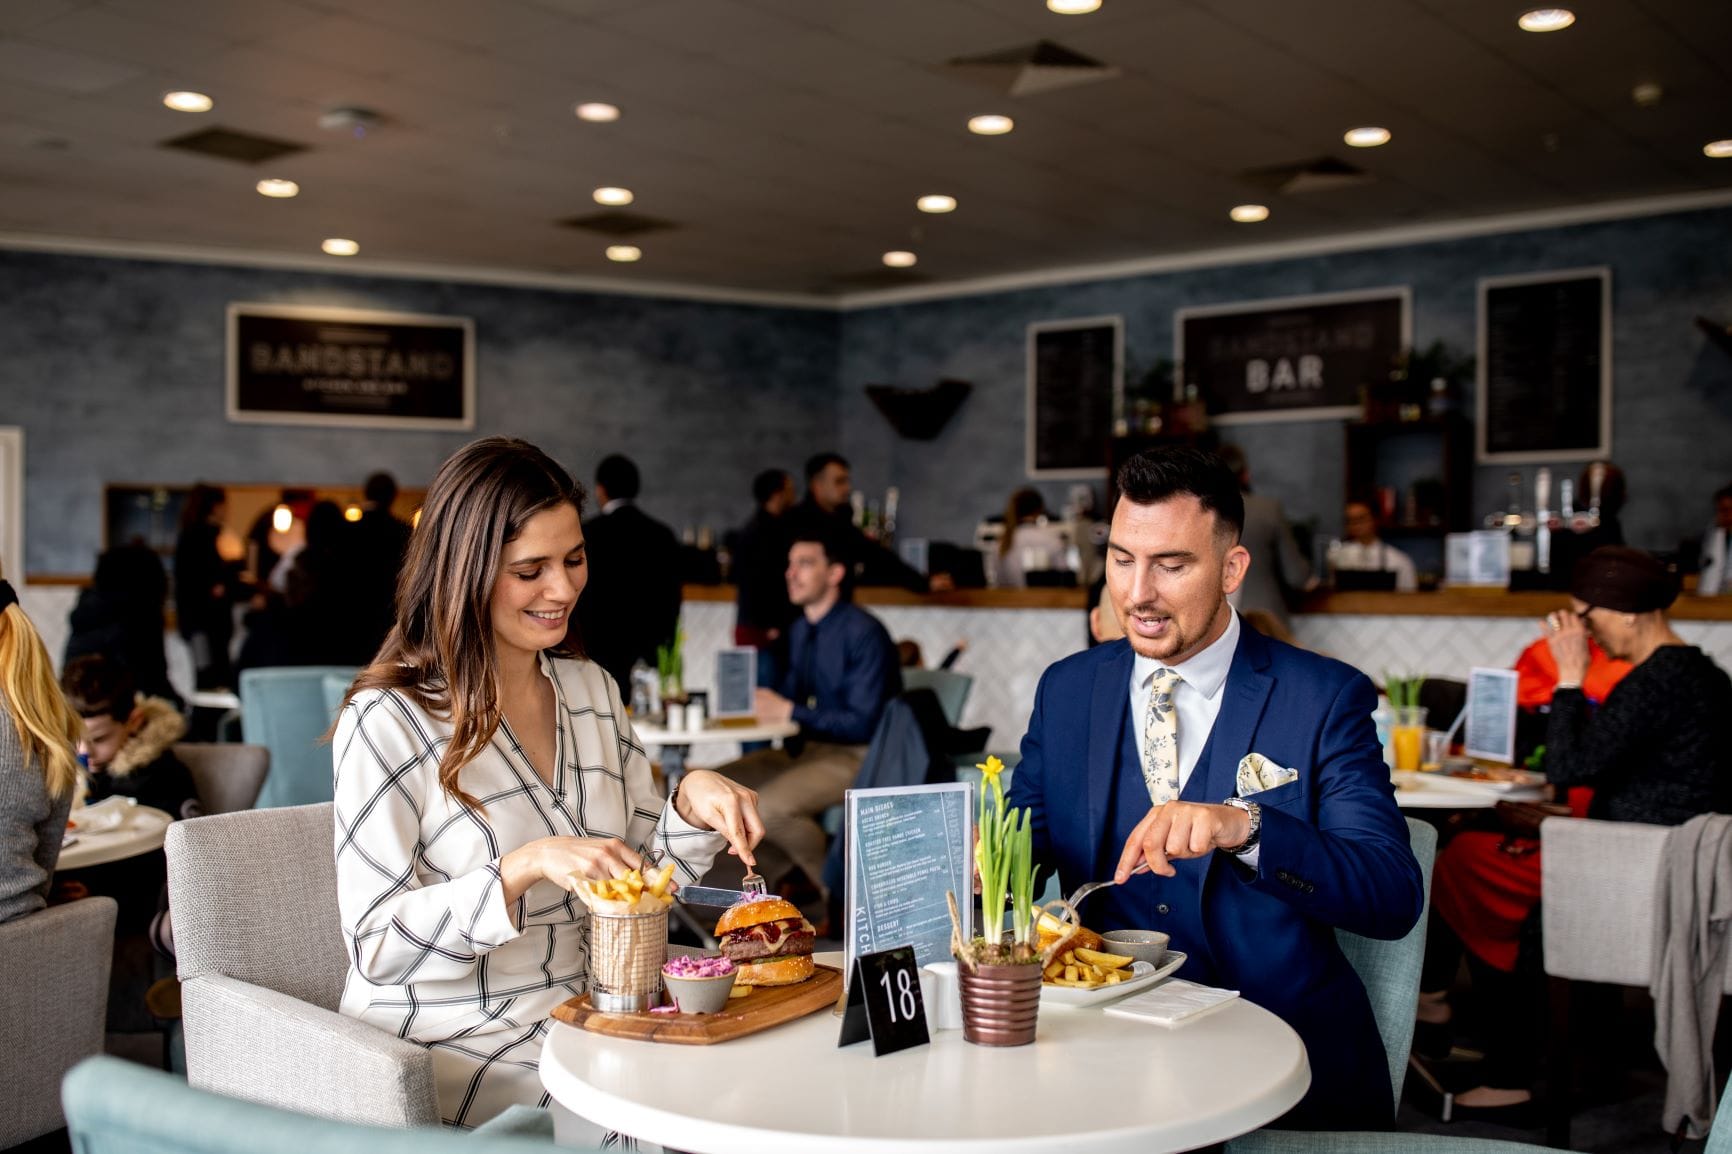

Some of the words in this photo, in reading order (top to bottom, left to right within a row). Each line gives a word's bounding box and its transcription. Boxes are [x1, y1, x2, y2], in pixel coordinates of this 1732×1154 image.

[251, 342, 454, 380] BANDSTAND
[1246, 354, 1324, 393] BAR
[860, 805, 874, 816] MAIN
[877, 920, 899, 932] DESSERT
[880, 968, 916, 1023] 18
